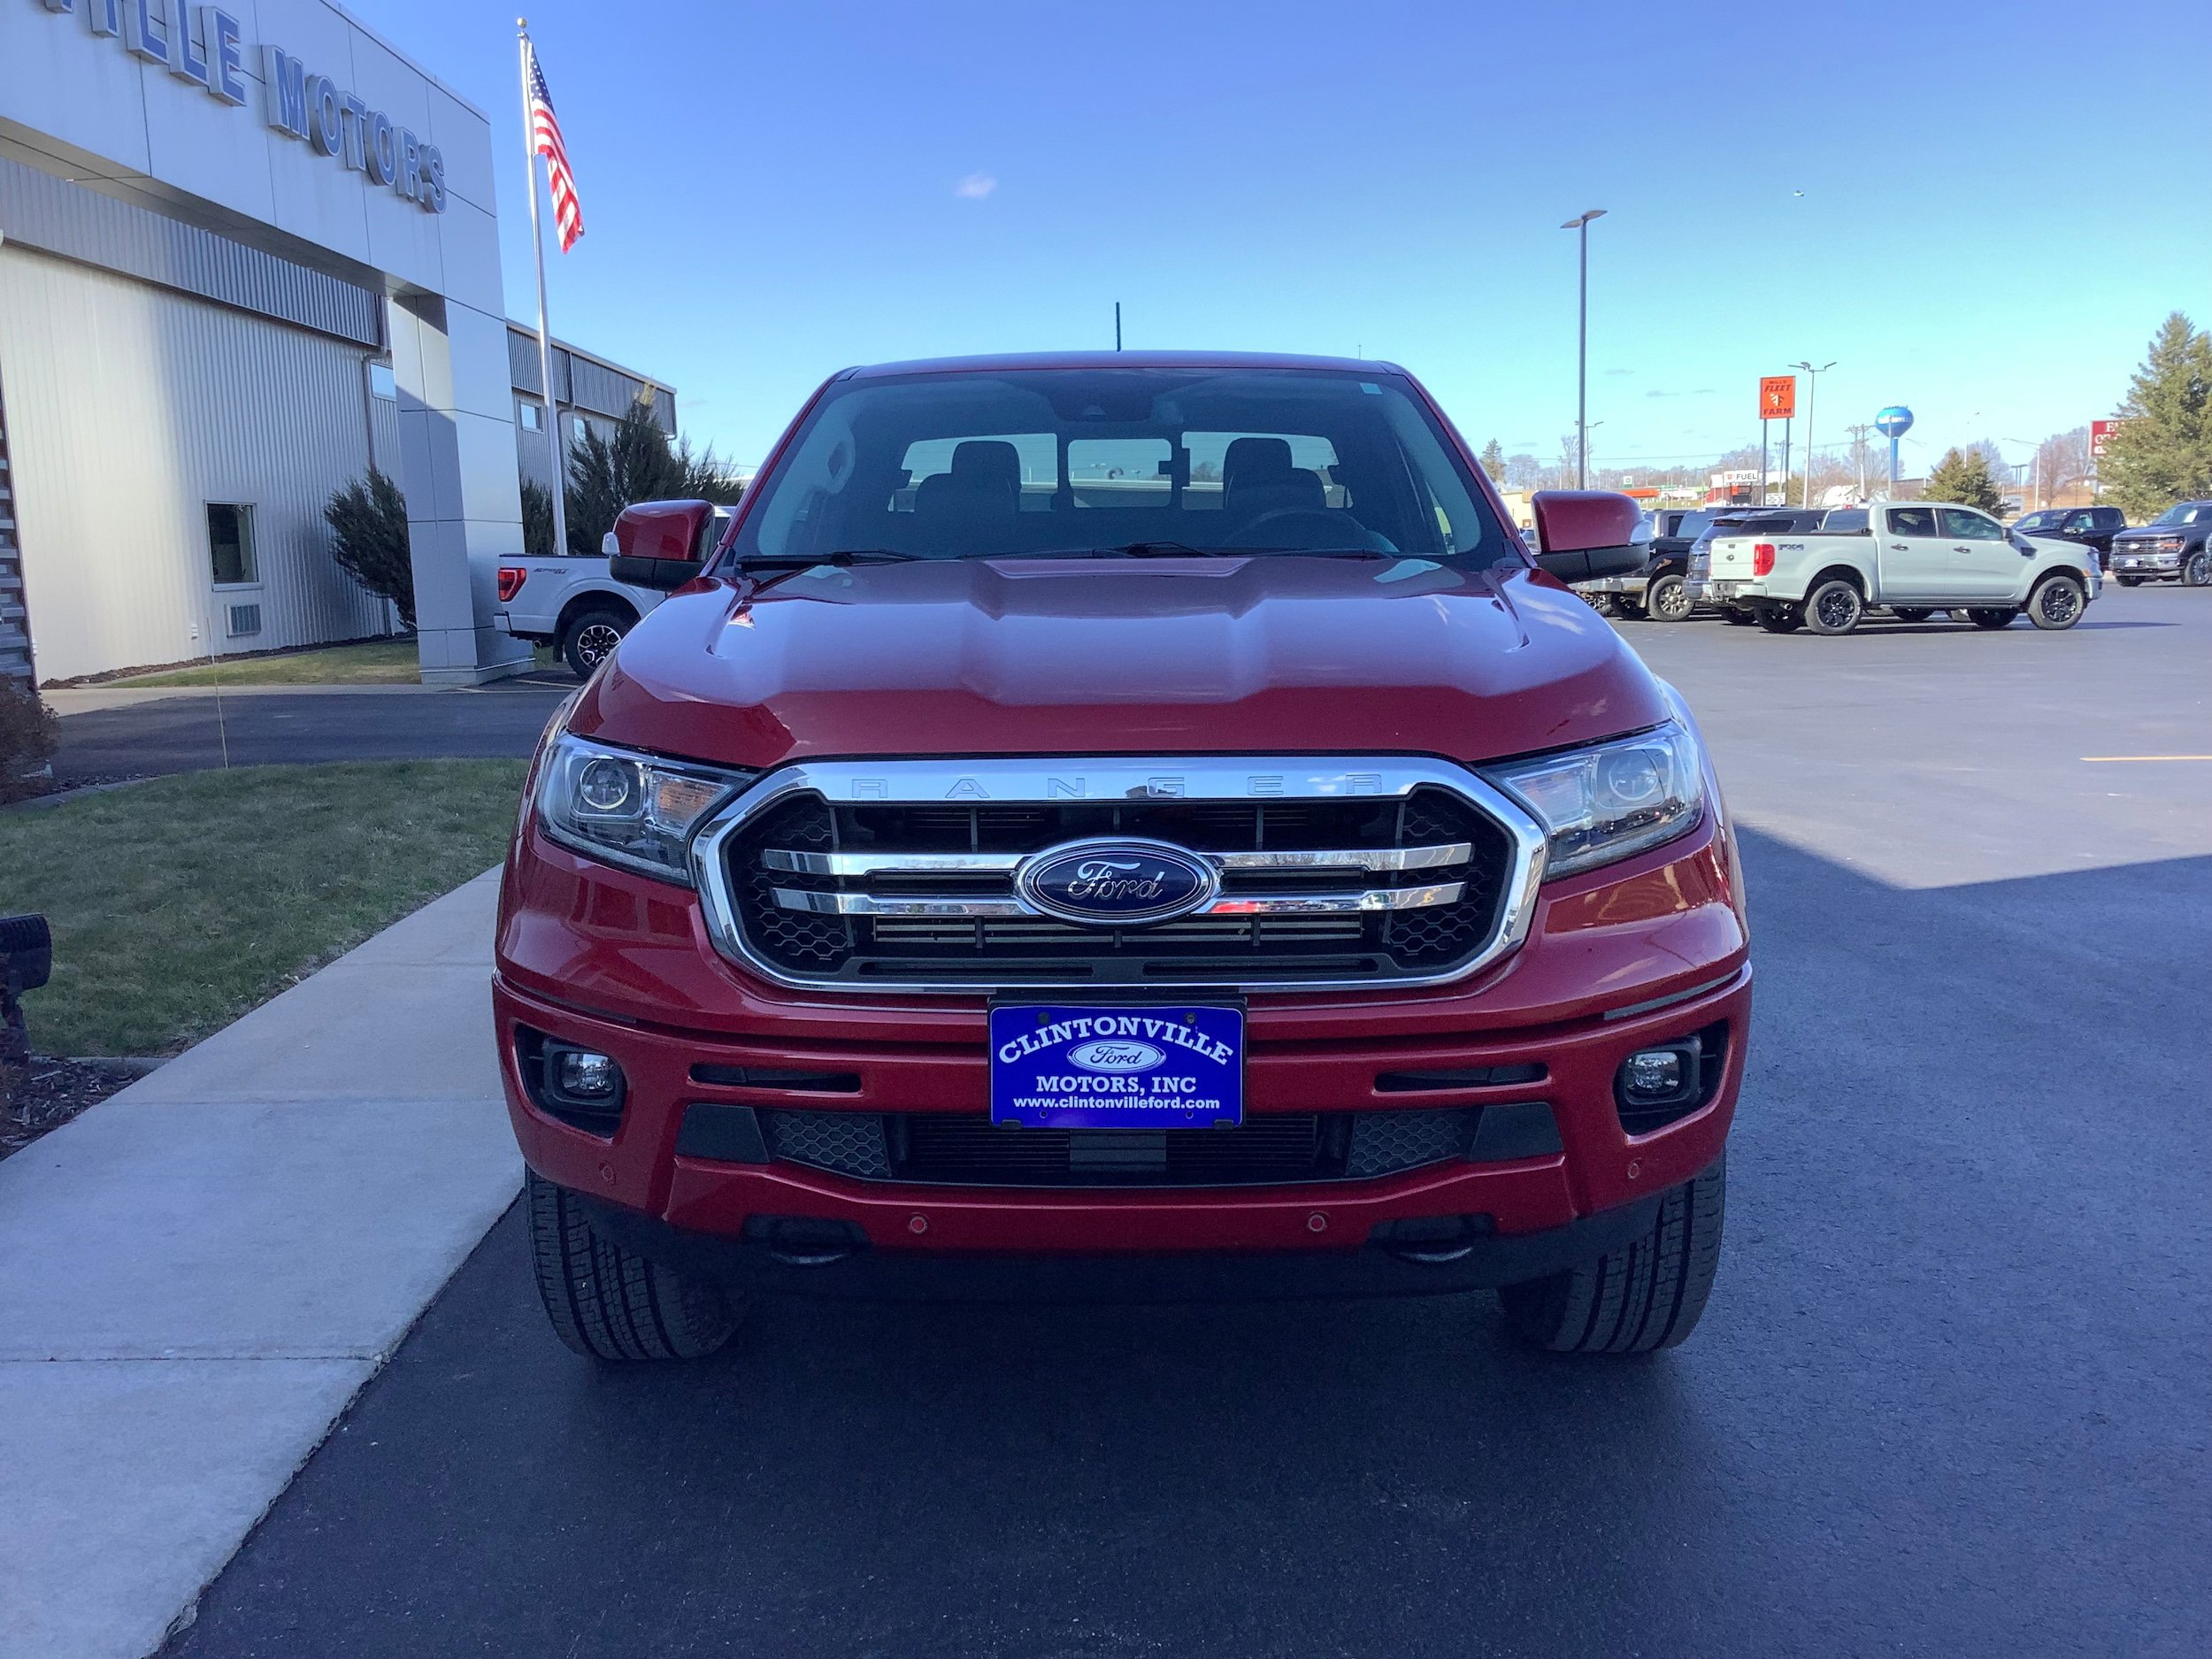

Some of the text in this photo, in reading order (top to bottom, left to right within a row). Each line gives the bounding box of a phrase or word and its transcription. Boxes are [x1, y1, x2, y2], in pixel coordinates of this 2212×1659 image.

[263, 44, 448, 214] MOTORS
[1763, 407, 1793, 416] FARM
[851, 773, 1382, 799] RANGER
[1068, 860, 1166, 900] Ford
[999, 1017, 1233, 1065] CLINTONVILLE
[1090, 1046, 1143, 1065] Ford
[1035, 1075, 1196, 1095] MOTORS, INC
[1013, 1095, 1220, 1110] www.clintonvilleford.com
